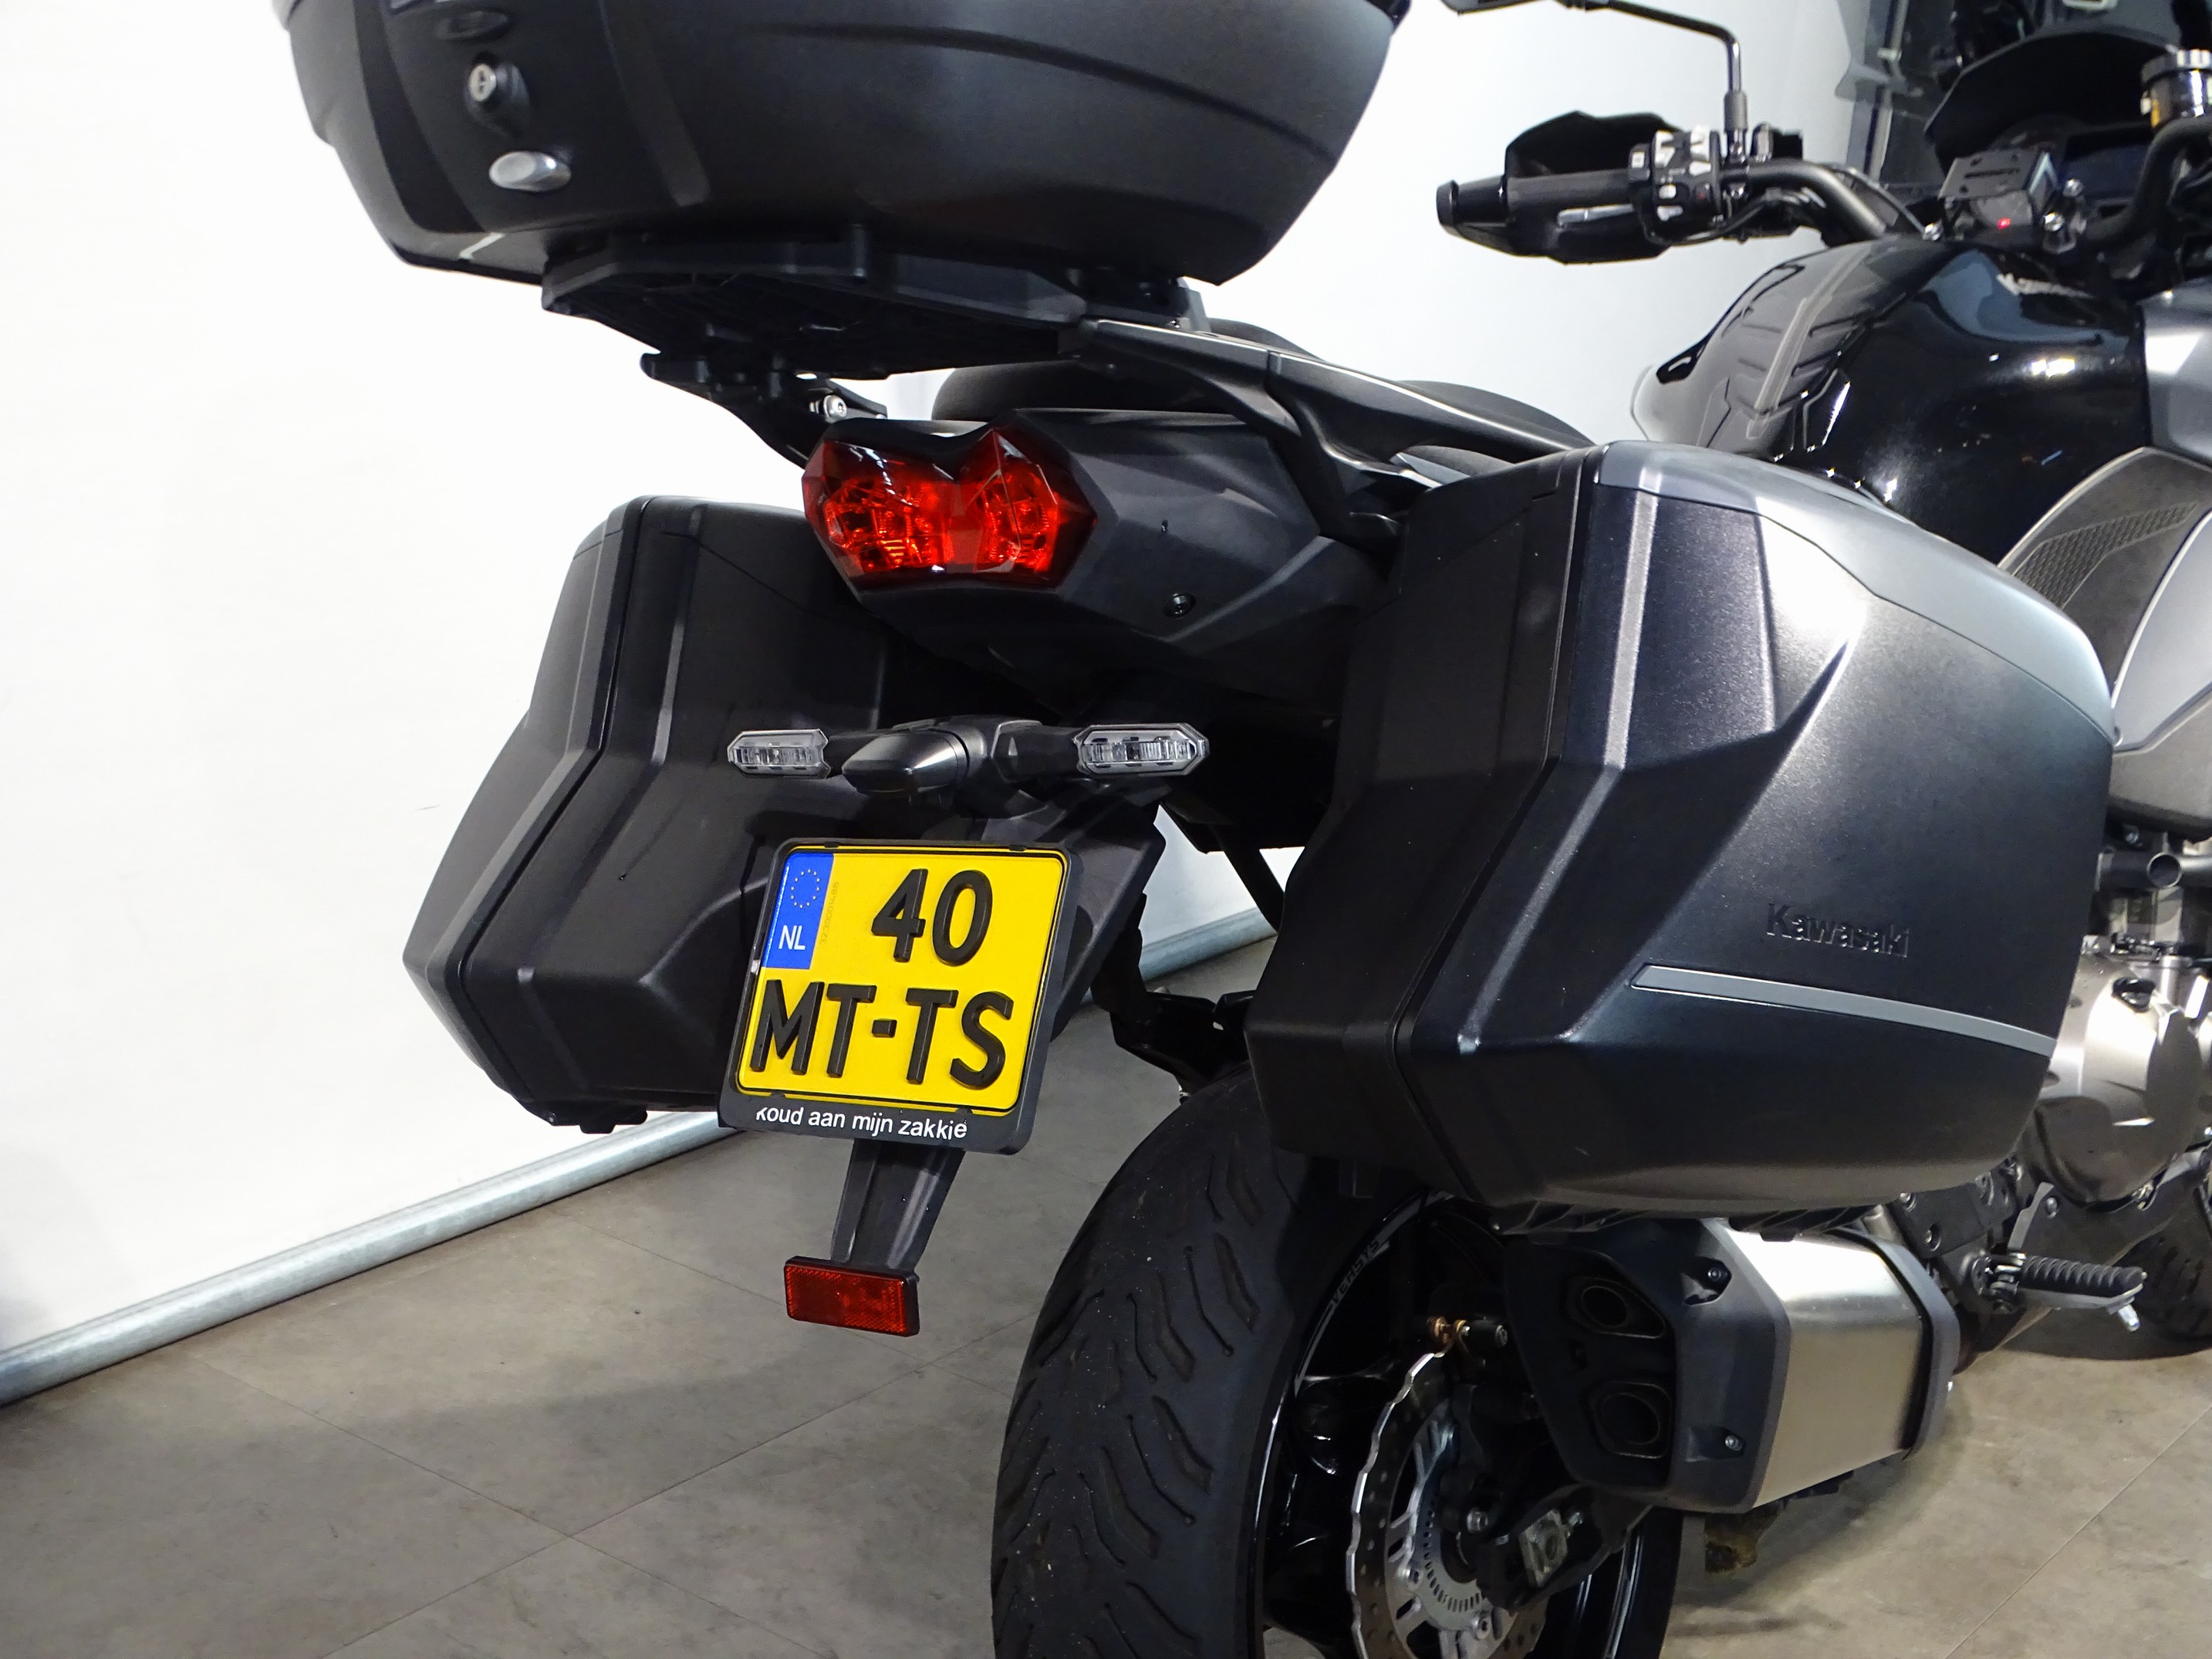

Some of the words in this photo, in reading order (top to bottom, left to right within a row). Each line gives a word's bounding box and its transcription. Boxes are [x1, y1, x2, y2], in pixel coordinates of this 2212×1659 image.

[778, 924, 806, 951] NL
[871, 868, 993, 967] 40
[1766, 904, 1910, 958] Kawasaki
[749, 979, 1015, 1090] MT-TS
[808, 1110, 846, 1128] aan
[852, 1112, 893, 1137] mijn
[897, 1118, 968, 1140] zakkie
